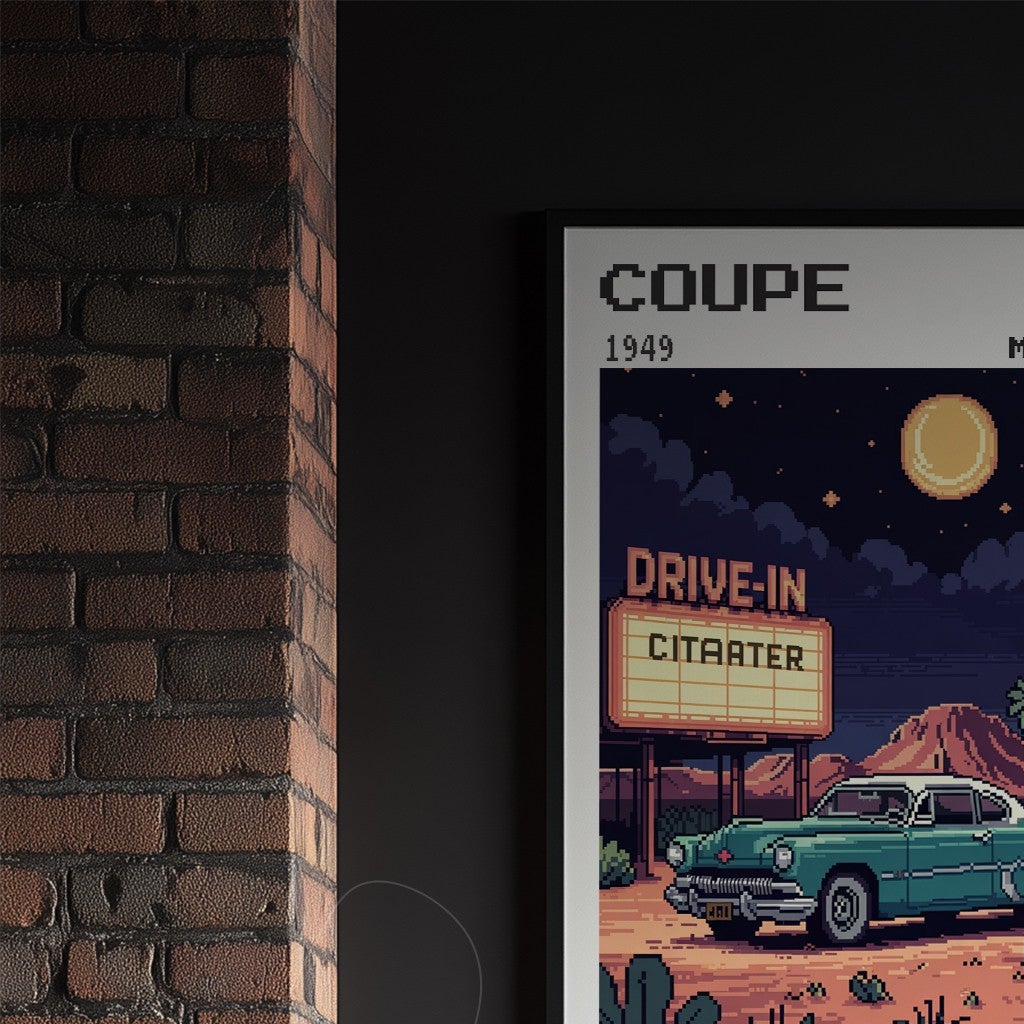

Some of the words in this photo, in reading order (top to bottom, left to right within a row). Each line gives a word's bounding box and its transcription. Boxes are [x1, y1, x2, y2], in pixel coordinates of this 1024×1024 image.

[600, 263, 850, 312] COUPE
[606, 334, 674, 362] 1949
[626, 546, 807, 612] DRIVE-IN
